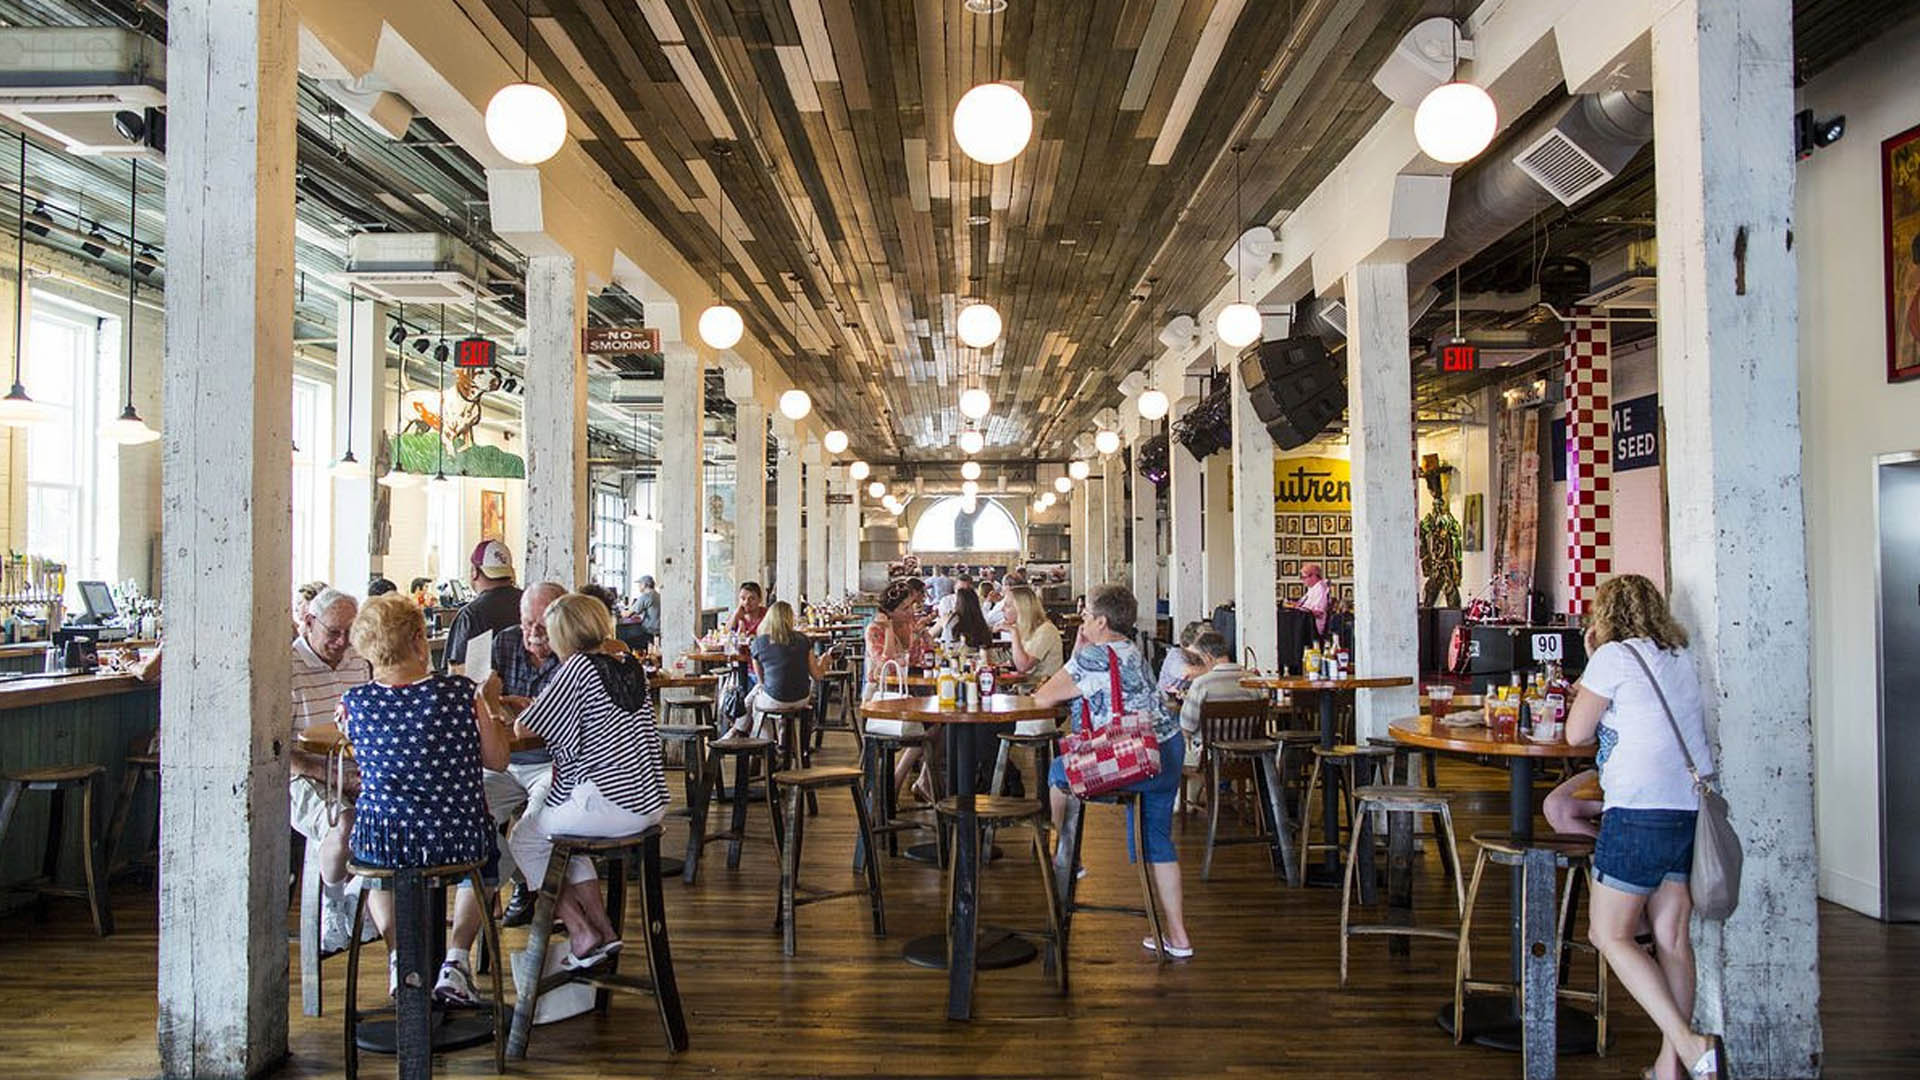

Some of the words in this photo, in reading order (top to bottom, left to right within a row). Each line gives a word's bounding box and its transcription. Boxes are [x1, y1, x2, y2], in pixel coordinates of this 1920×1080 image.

[590, 340, 651, 351] SMOKING
[608, 331, 632, 340] NO
[461, 341, 488, 366] EXIT
[1443, 346, 1473, 371] EXIT
[1618, 433, 1655, 460] SEED
[1539, 635, 1557, 652] 90
